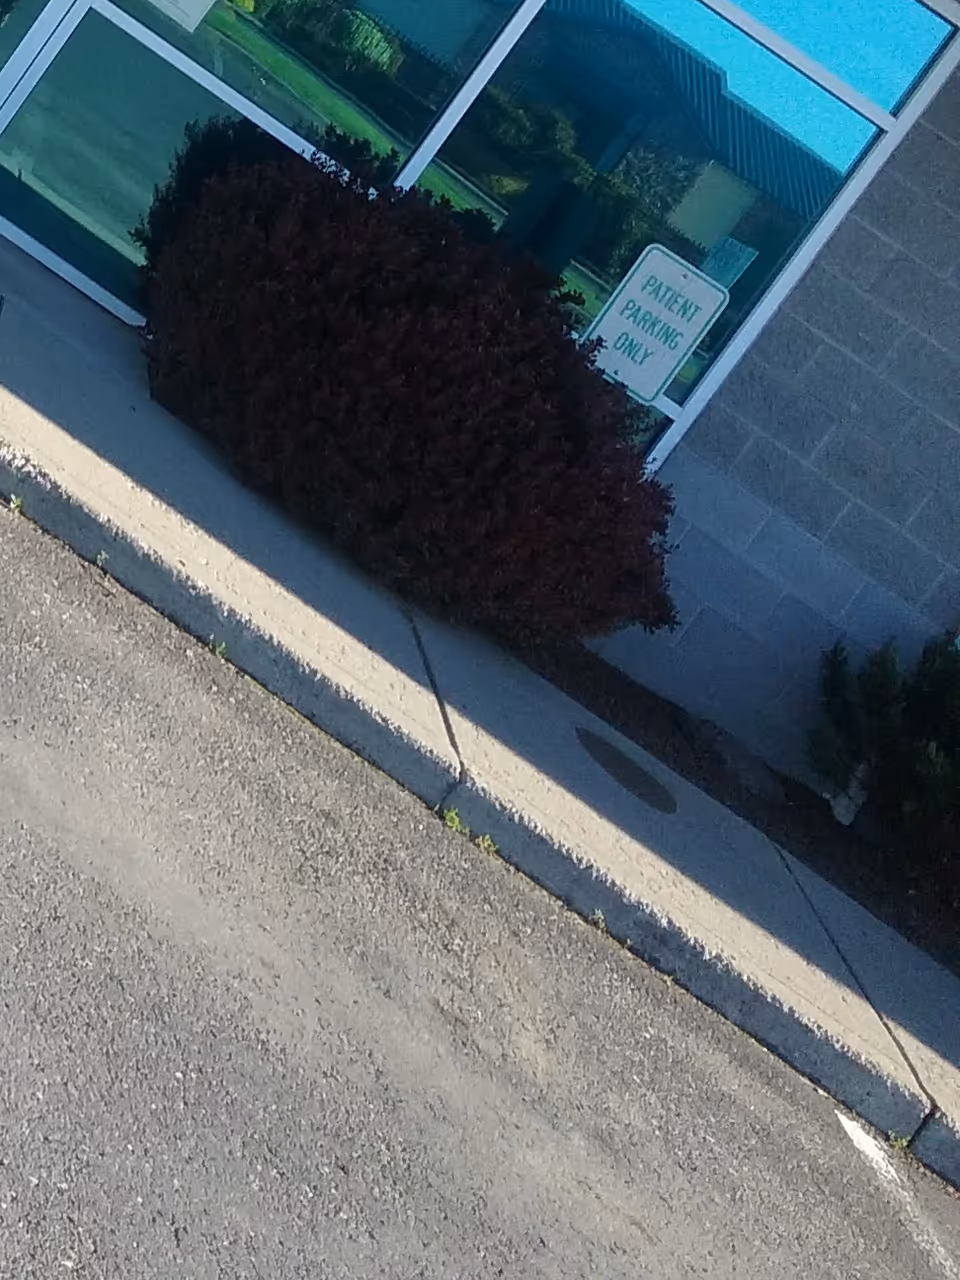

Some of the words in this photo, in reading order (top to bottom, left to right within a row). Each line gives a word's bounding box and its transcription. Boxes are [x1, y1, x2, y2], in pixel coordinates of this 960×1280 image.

[641, 274, 703, 323] PATIENT
[612, 331, 656, 366] ONLY
[619, 299, 684, 351] PARKING
